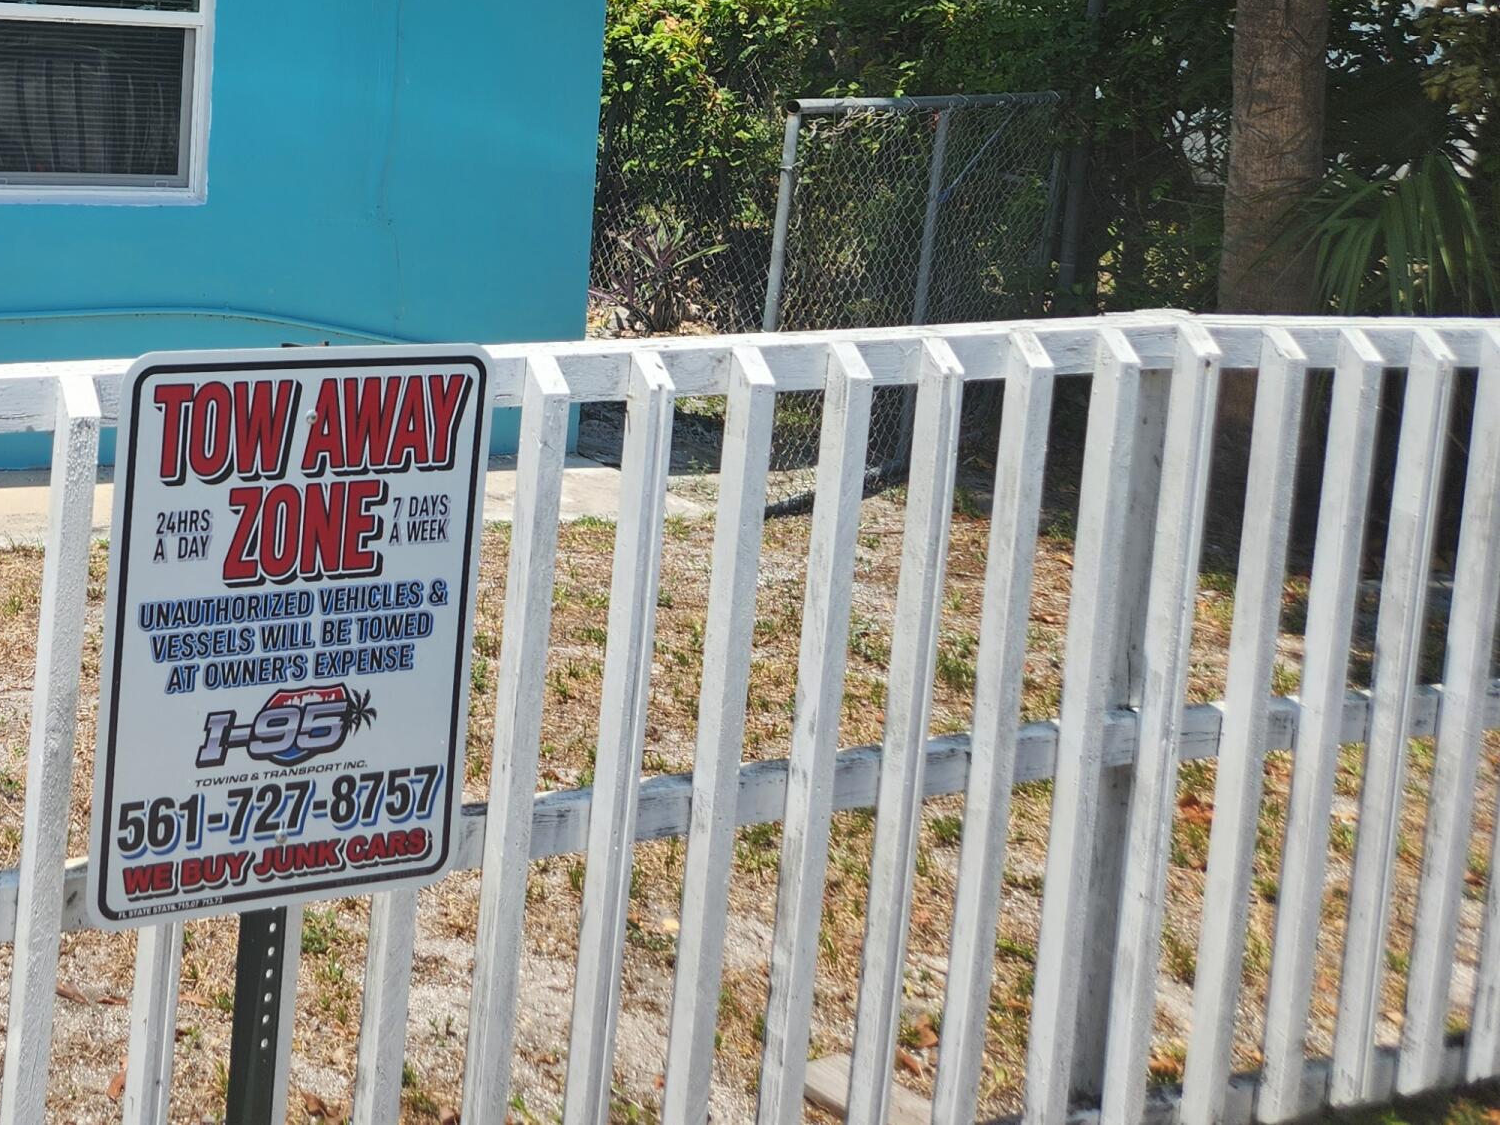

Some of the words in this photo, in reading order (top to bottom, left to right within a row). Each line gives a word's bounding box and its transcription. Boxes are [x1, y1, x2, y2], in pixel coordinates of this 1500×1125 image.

[154, 379, 302, 486] TOW
[301, 374, 473, 475] AWAY
[155, 509, 211, 536] 24HRS
[389, 520, 401, 544] A
[406, 518, 447, 543] WEEK
[393, 496, 402, 519] 7
[408, 494, 449, 518] DAYS
[153, 538, 166, 563] A
[177, 534, 210, 560] DAY
[222, 479, 389, 588] ZONE
[139, 589, 314, 631] UNAUTHORIZED
[318, 580, 424, 616] VEHICLES
[428, 578, 448, 606] &
[151, 627, 254, 662] VESSELS
[261, 622, 315, 652] WILL
[320, 618, 351, 646] BE
[356, 611, 434, 644] TOWED
[165, 663, 198, 694] AT
[204, 653, 309, 689] OWNER'S
[314, 644, 415, 679] EXPENSE
[195, 699, 351, 769] I-95
[195, 774, 249, 788] TOWING
[251, 772, 259, 781] &
[262, 762, 342, 779] TRANSPORT
[343, 760, 368, 770] INC.
[117, 764, 445, 860] 561-727-8757
[122, 862, 179, 902] WE
[179, 850, 254, 895] BUY
[252, 837, 347, 880] JUNK
[346, 826, 434, 870] CARS
[129, 907, 151, 918] STATE
